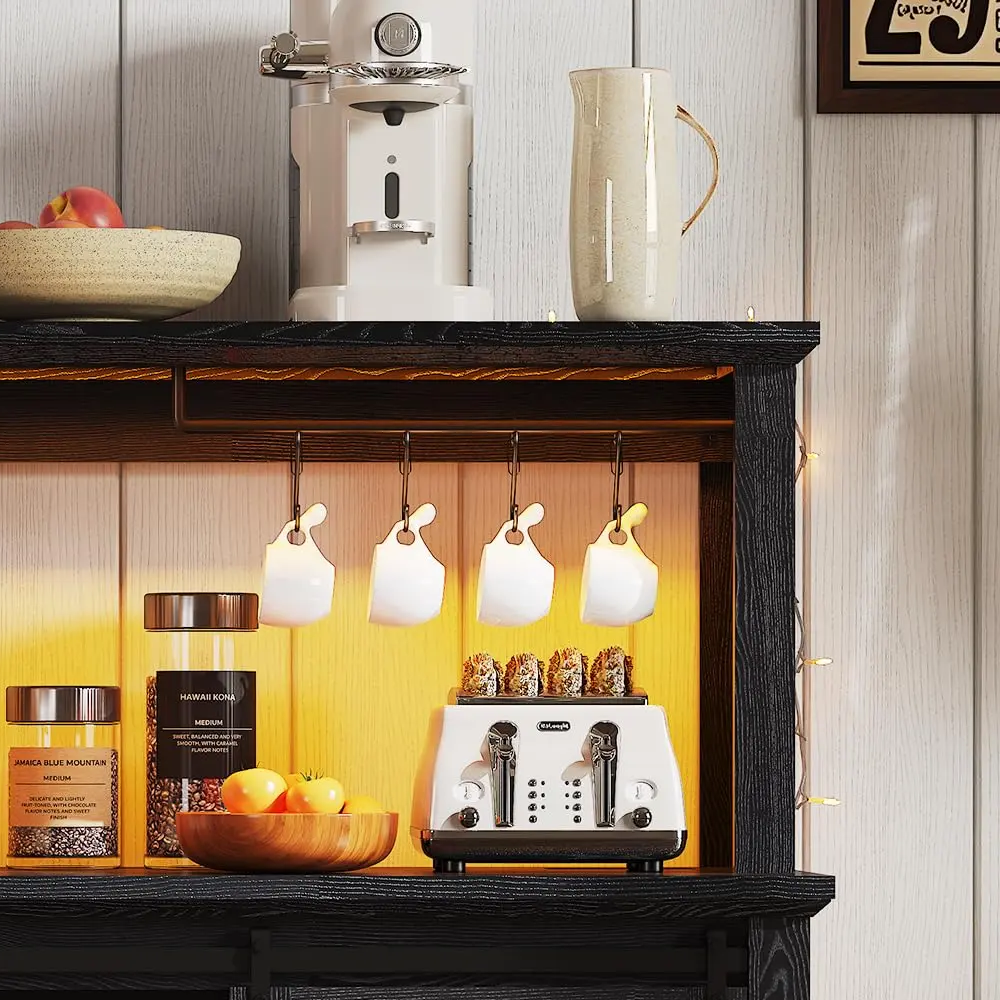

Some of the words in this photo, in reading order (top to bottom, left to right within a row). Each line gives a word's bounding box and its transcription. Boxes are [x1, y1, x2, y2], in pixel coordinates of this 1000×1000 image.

[180, 693, 212, 701] HAWAII
[212, 693, 236, 701] KONA
[14, 759, 42, 767] JAMAICA
[43, 759, 65, 767] BLUE
[66, 759, 107, 767] MOUNTAIN
